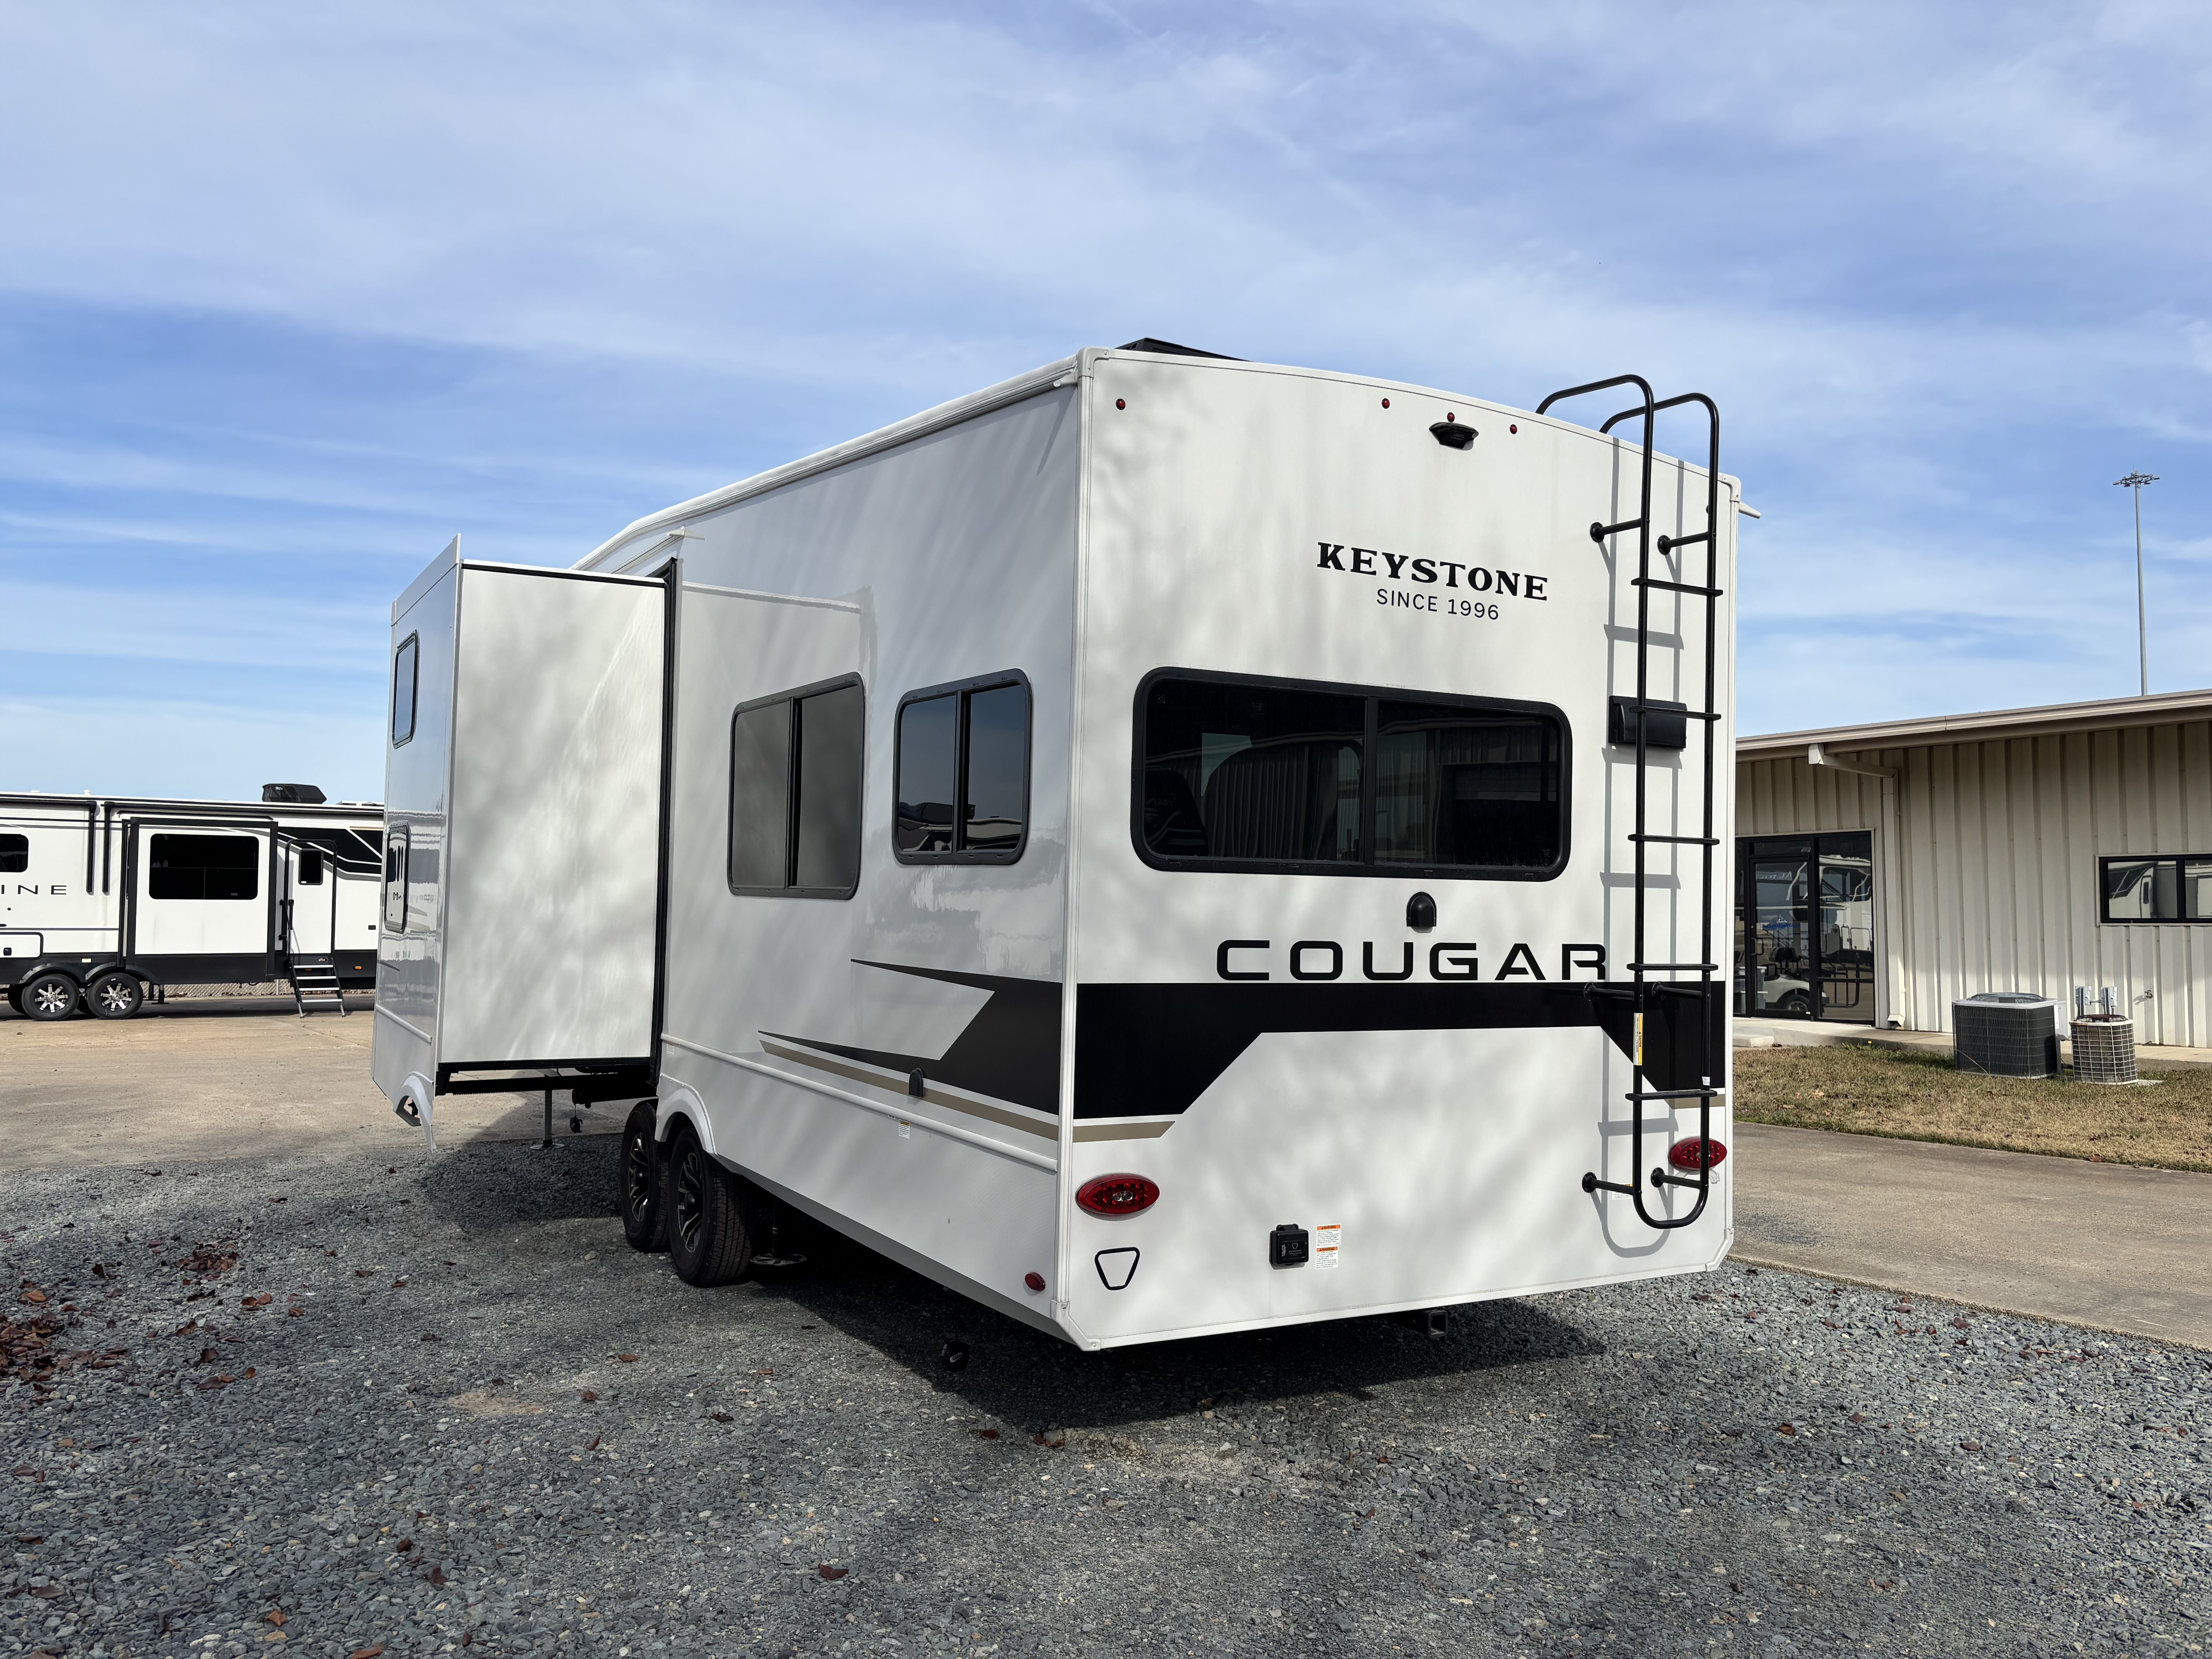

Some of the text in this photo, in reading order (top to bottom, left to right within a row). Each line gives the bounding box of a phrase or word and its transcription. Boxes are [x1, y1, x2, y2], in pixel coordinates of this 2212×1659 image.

[1317, 542, 1548, 601] KEYSTONE
[1377, 589, 1499, 620] SINCE 1996
[1, 884, 67, 895] INE
[1216, 939, 1606, 981] COUGAR
